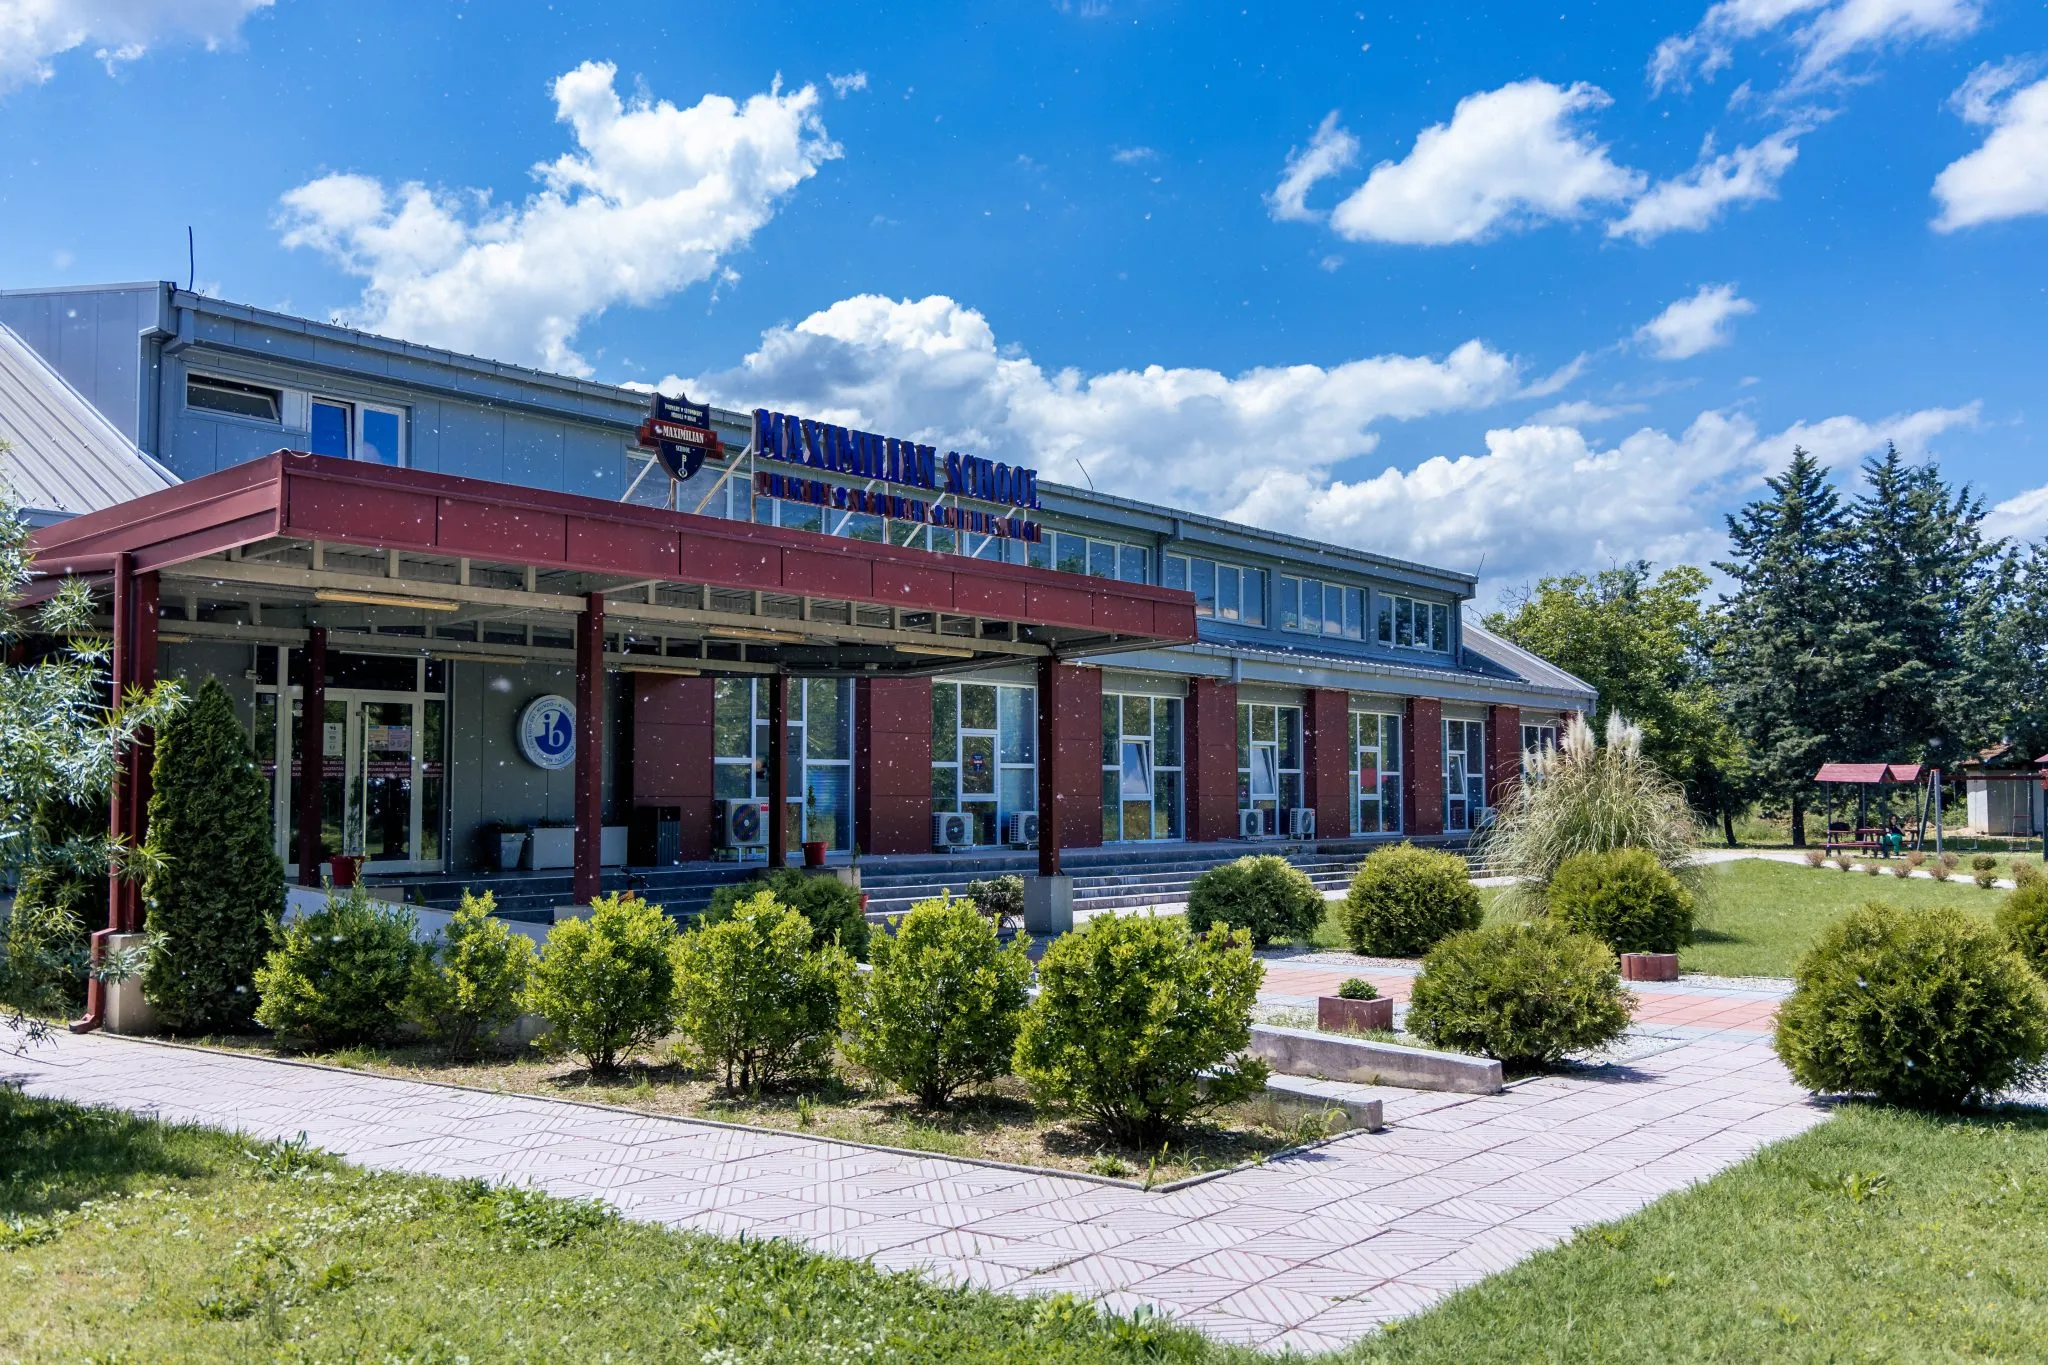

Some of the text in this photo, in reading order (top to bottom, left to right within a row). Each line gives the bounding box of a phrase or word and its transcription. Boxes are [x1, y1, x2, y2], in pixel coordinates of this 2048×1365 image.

[662, 425, 704, 444] MAXIMILIAN
[675, 445, 691, 453] SCHOOL
[753, 408, 1041, 511] MAXIMILIAN SCHOOL
